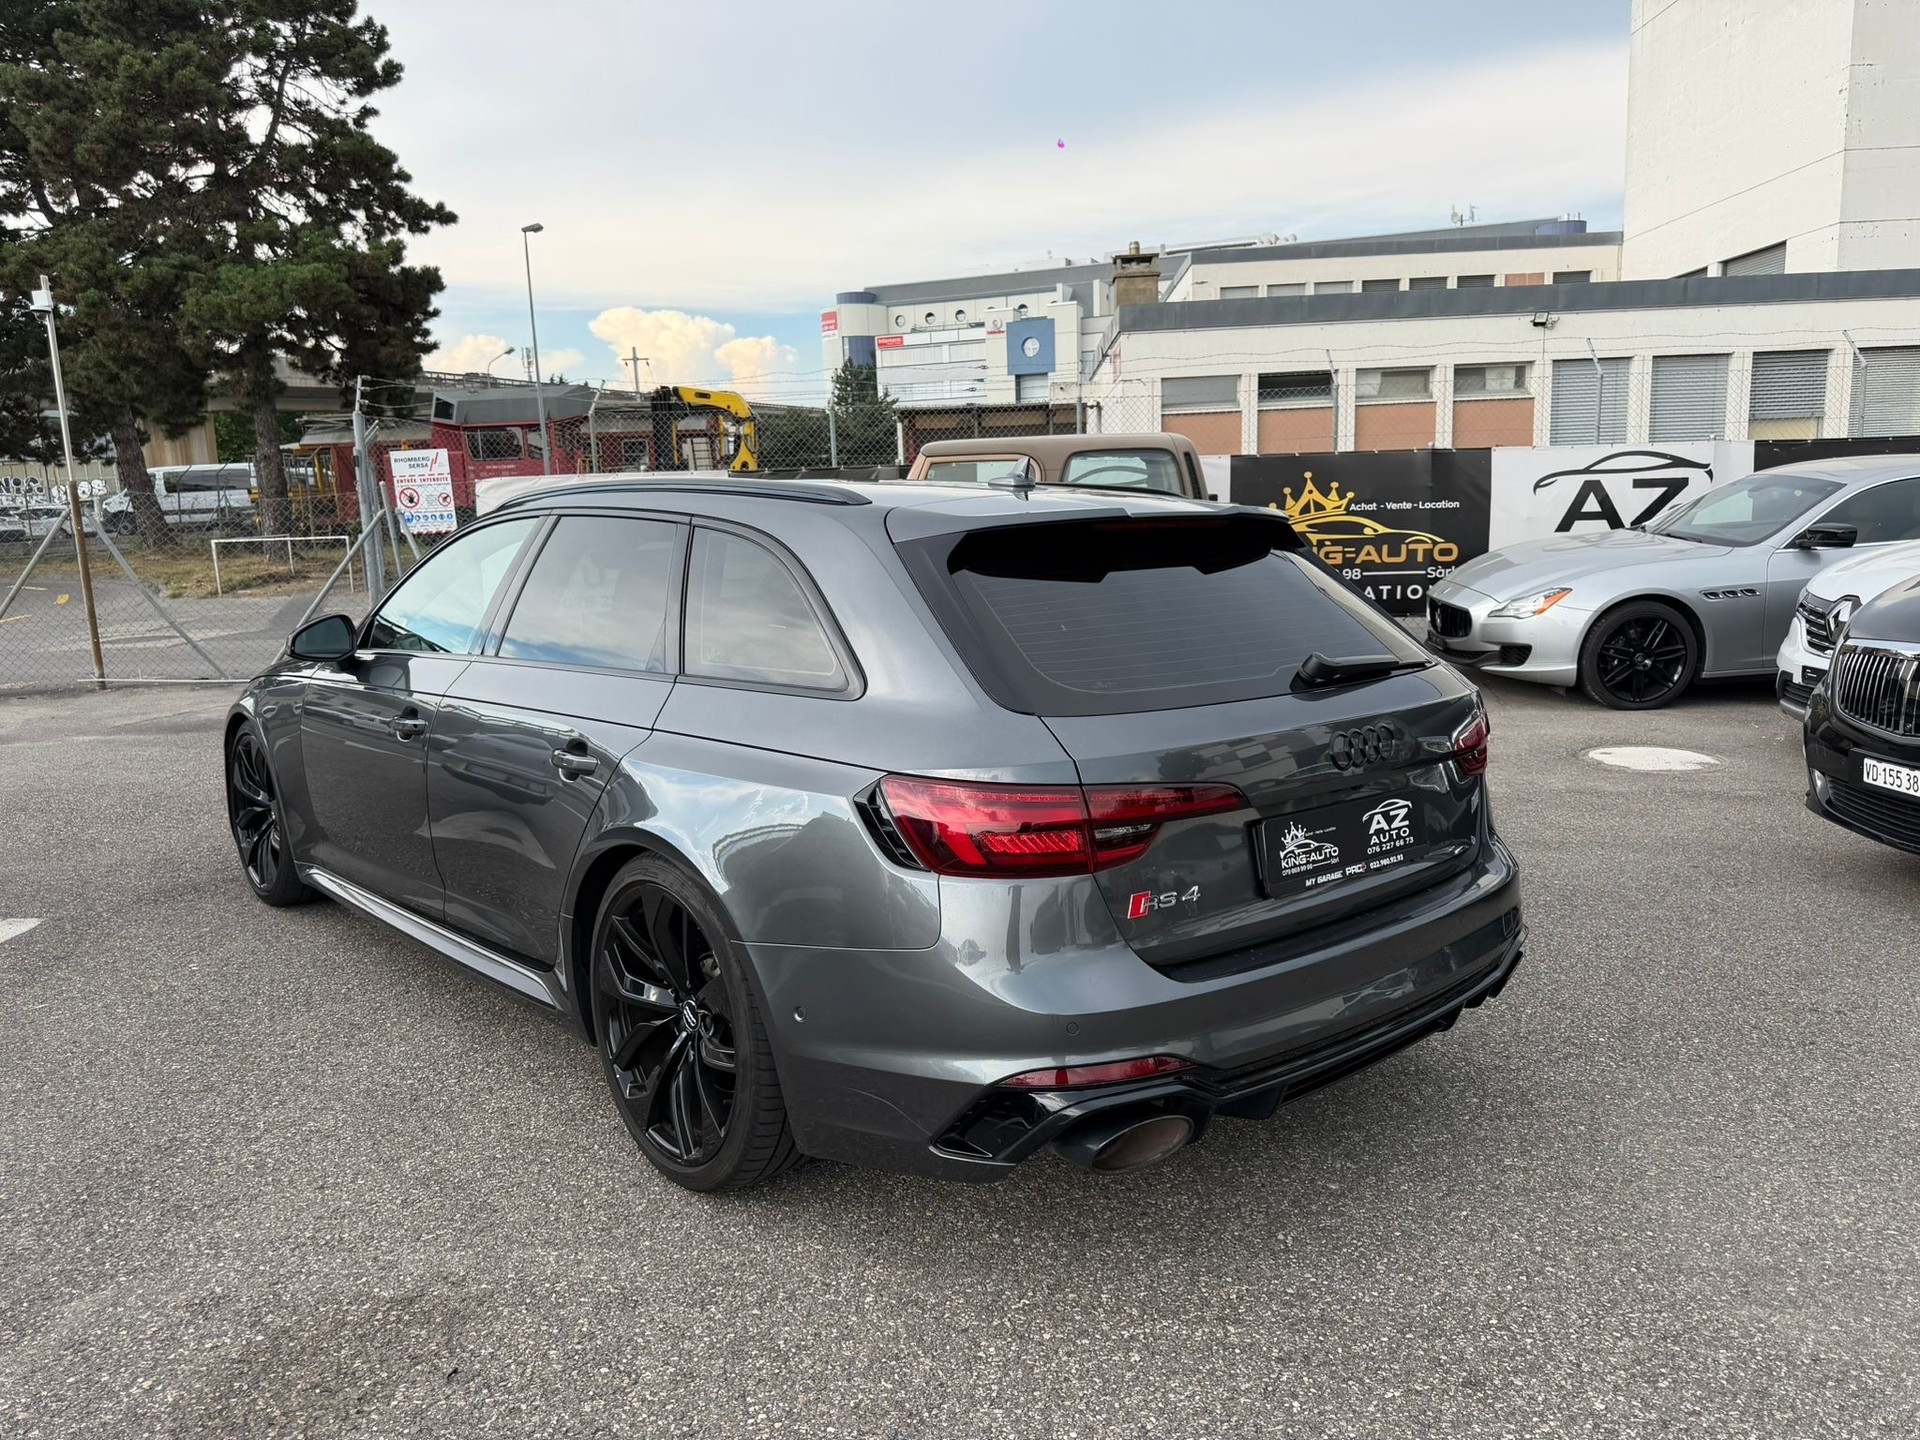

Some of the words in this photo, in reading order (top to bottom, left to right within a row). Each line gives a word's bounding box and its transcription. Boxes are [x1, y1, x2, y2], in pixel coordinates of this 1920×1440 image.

[1349, 502, 1377, 511] Achat
[1386, 500, 1412, 510] Vente
[1419, 499, 1460, 509] Location
[1554, 477, 1690, 533] AZ
[1364, 585, 1433, 600] ATIO
[1369, 807, 1410, 835] AZ
[1367, 845, 1380, 855] 076
[1381, 841, 1394, 851] 227
[1395, 839, 1404, 847] 66
[1405, 836, 1414, 844] 73
[1370, 827, 1410, 846] AUTO
[1305, 878, 1316, 887] MY
[1317, 871, 1343, 884] GARAGE
[1140, 892, 1178, 914] RS
[1182, 885, 1201, 901] 4
